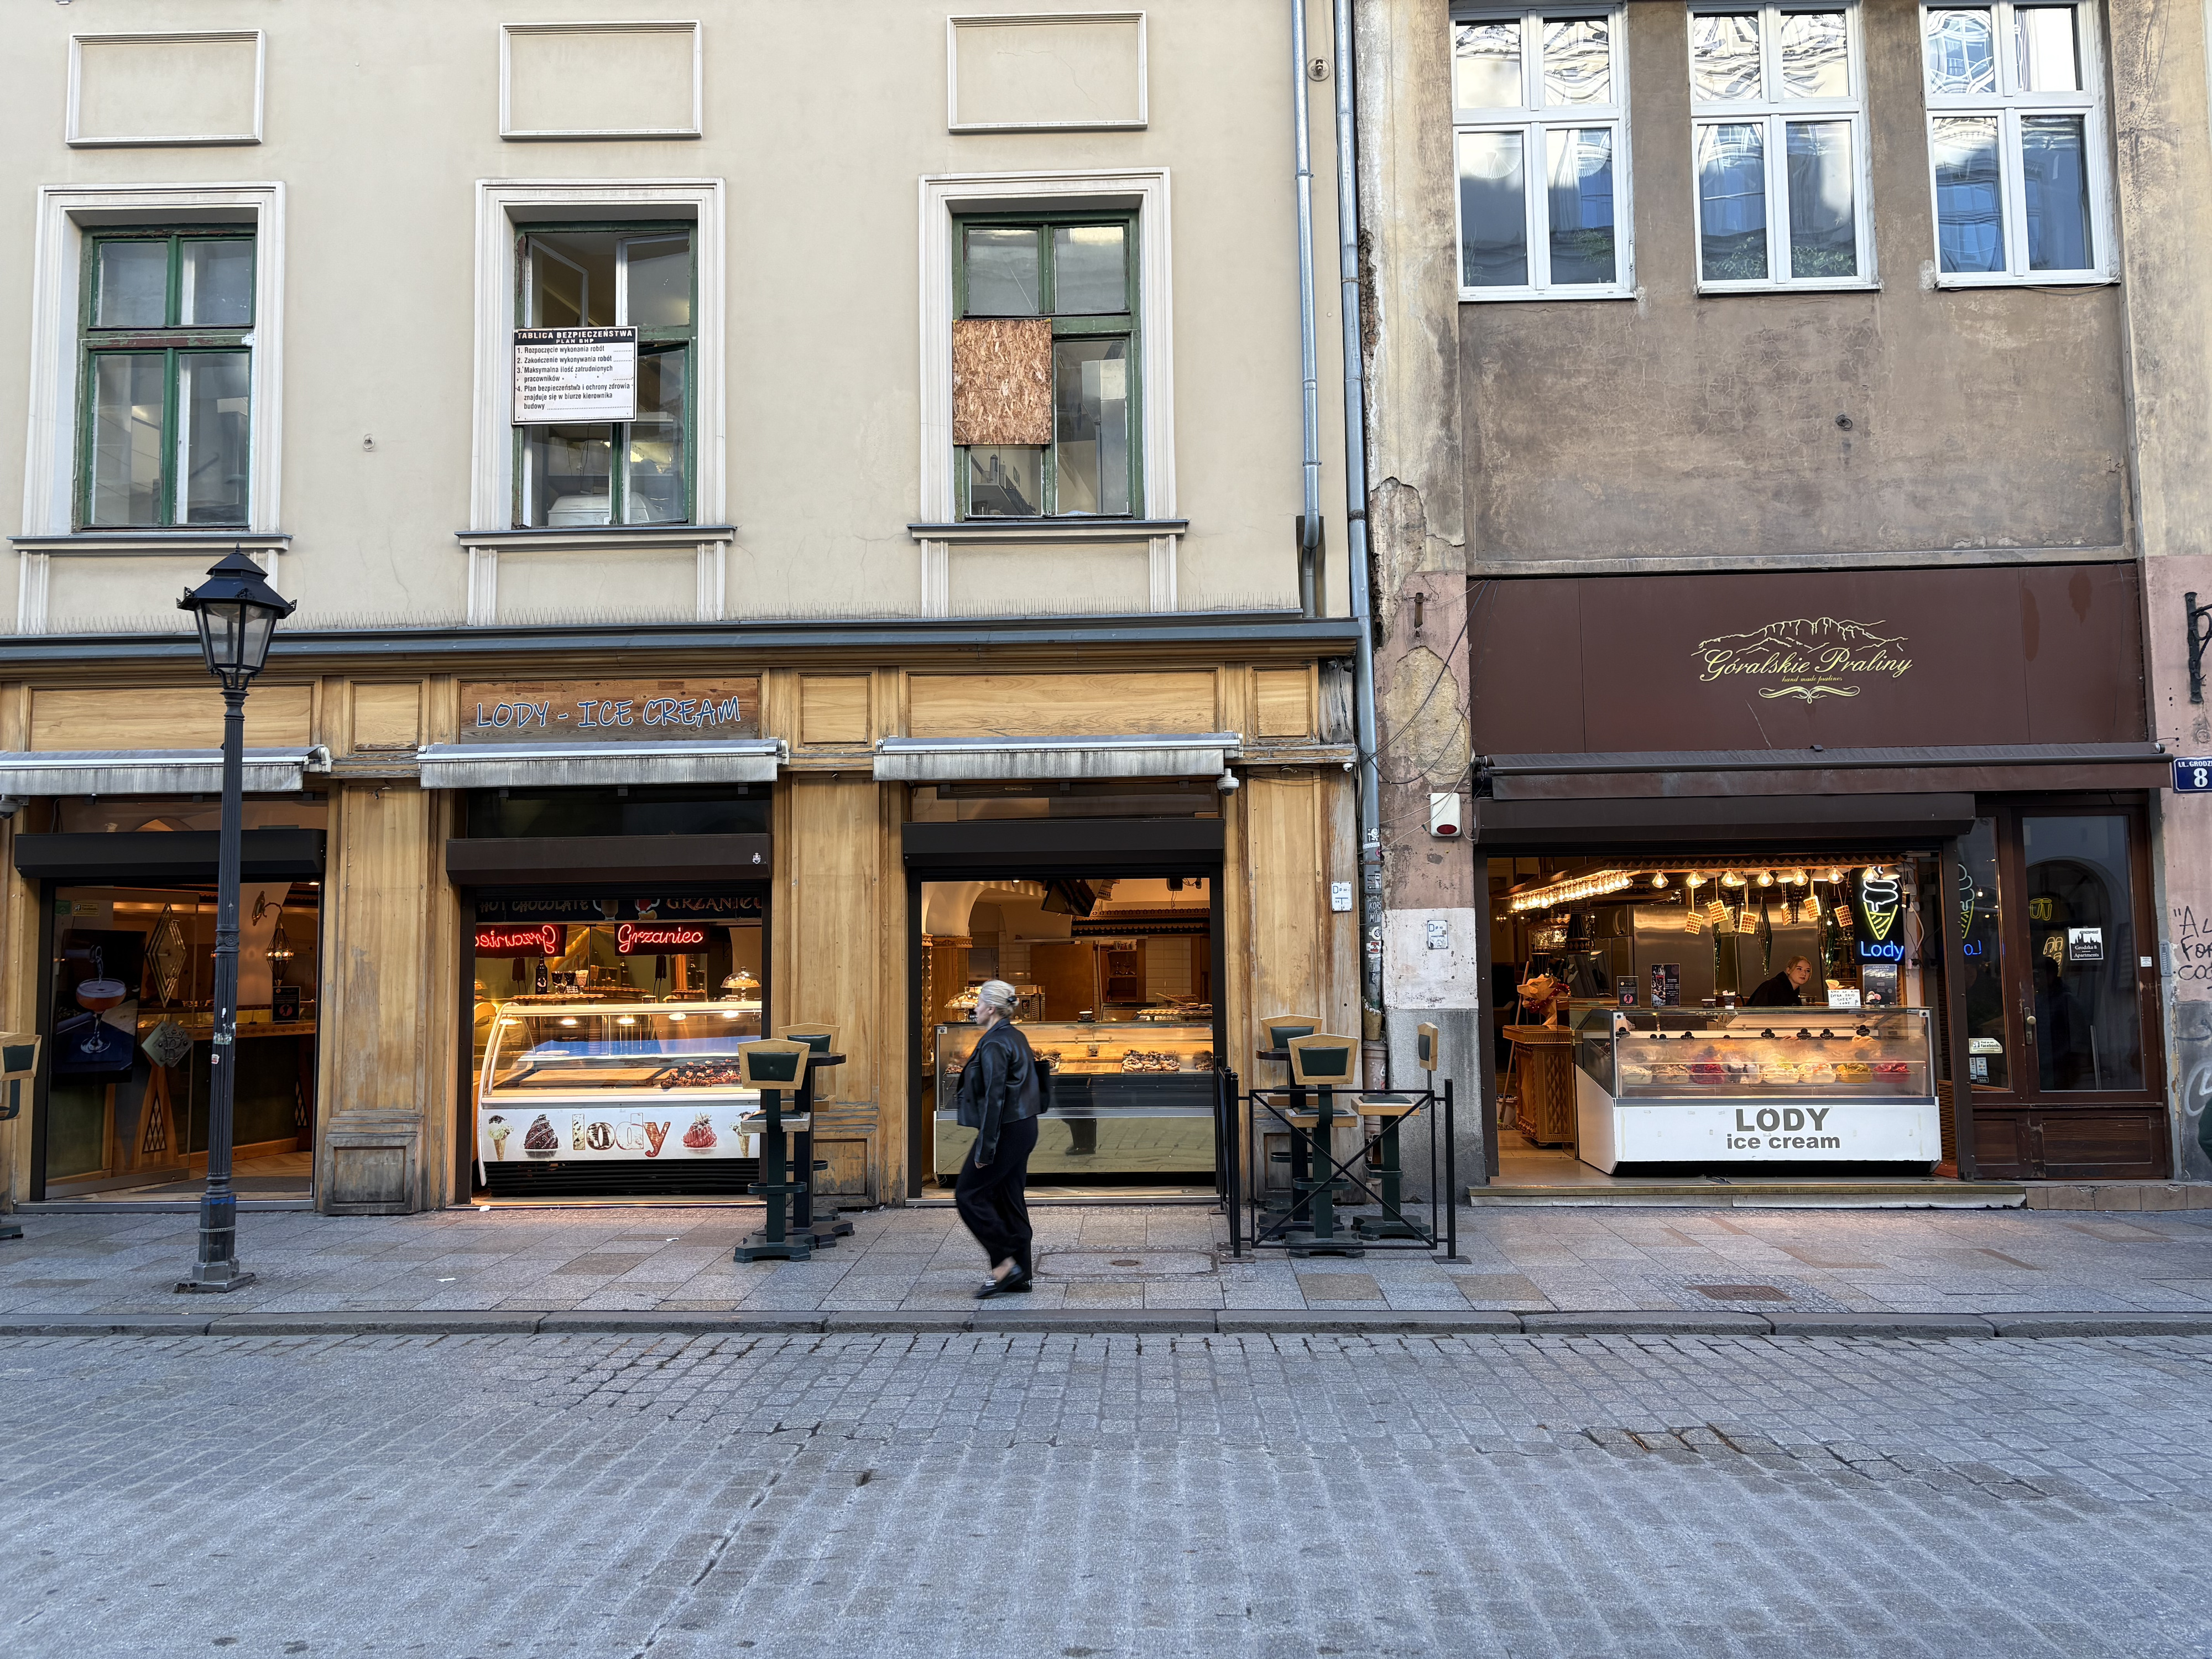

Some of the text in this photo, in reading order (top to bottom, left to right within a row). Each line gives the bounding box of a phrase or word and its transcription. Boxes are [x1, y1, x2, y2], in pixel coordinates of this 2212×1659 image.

[556, 329, 633, 338] BEZPIECZEŃSTWA
[524, 346, 558, 354] Rozpoczęcie
[560, 346, 589, 354] wykonania
[524, 366, 559, 374] Maksymalna
[575, 364, 613, 373] zatrudnionych
[524, 375, 560, 384] pracowników
[538, 384, 581, 393] bezpieczeństwa
[524, 393, 547, 402] znajduje
[549, 393, 557, 401] się
[1699, 646, 1913, 682] Góralskie Praliny
[1817, 674, 1843, 685] pralines
[476, 700, 550, 728] LODY
[577, 699, 634, 727] ICE
[643, 695, 741, 728] CREAM
[2193, 768, 2208, 787] 8
[618, 924, 703, 953] Grzaniec
[1860, 940, 1904, 961] Lody
[1735, 1108, 1830, 1132] LODY
[572, 1112, 671, 1157] lody
[1726, 1133, 1840, 1149] ice cream
